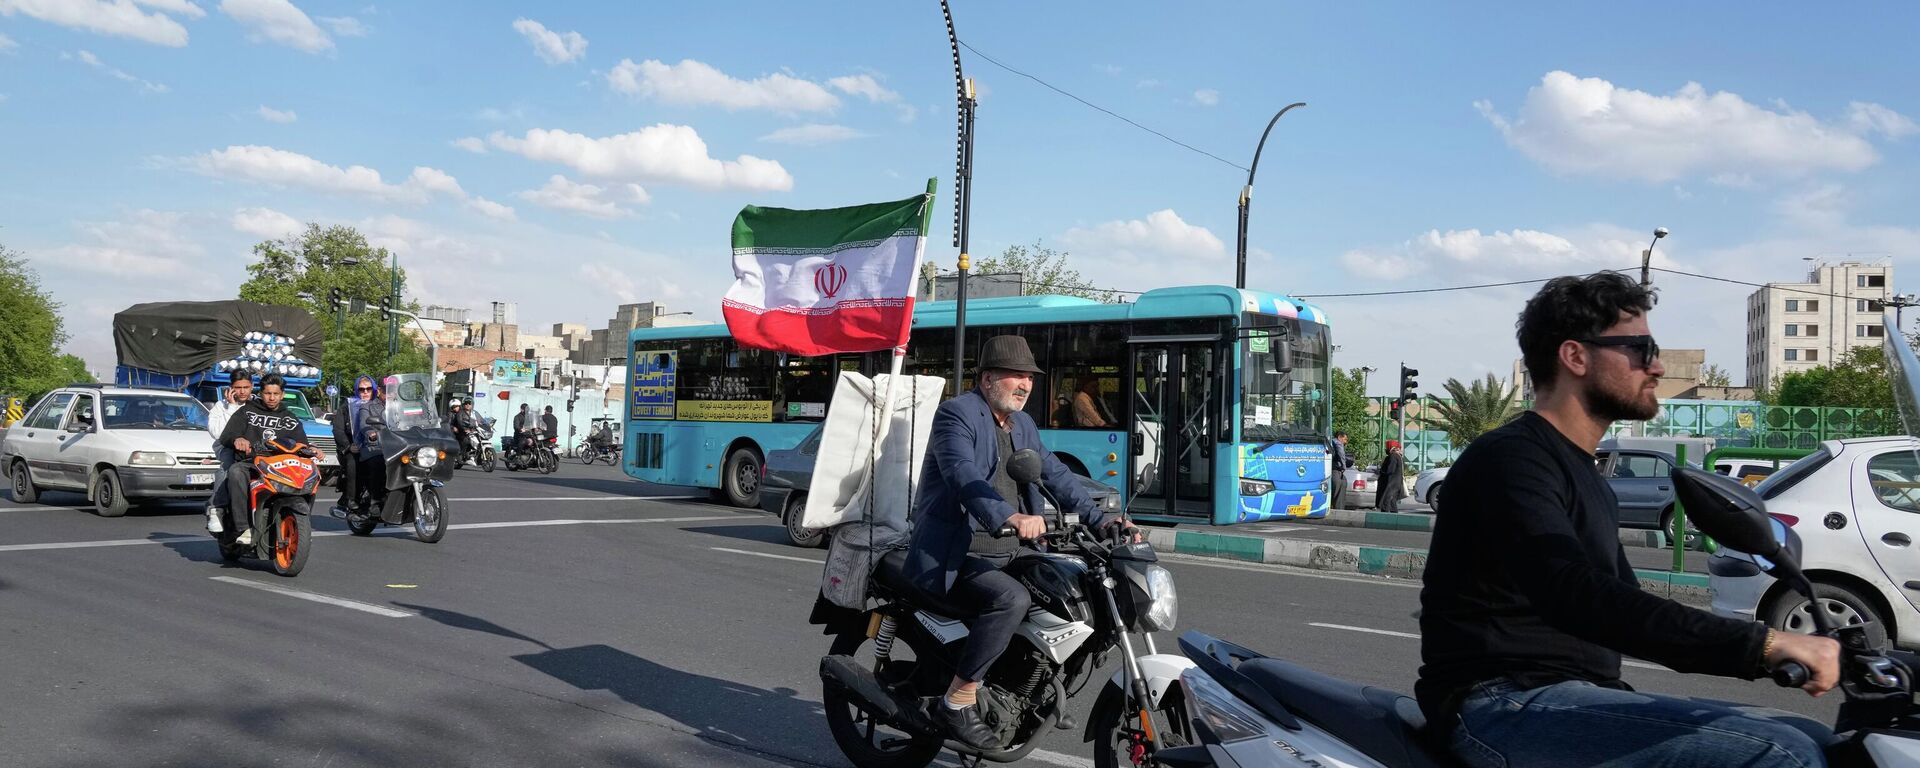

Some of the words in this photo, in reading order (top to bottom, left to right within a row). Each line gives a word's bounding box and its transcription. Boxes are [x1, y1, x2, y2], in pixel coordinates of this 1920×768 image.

[634, 405, 651, 416] LOVELY
[652, 405, 673, 416] TEHRAN
[245, 411, 299, 431] EAGLES
